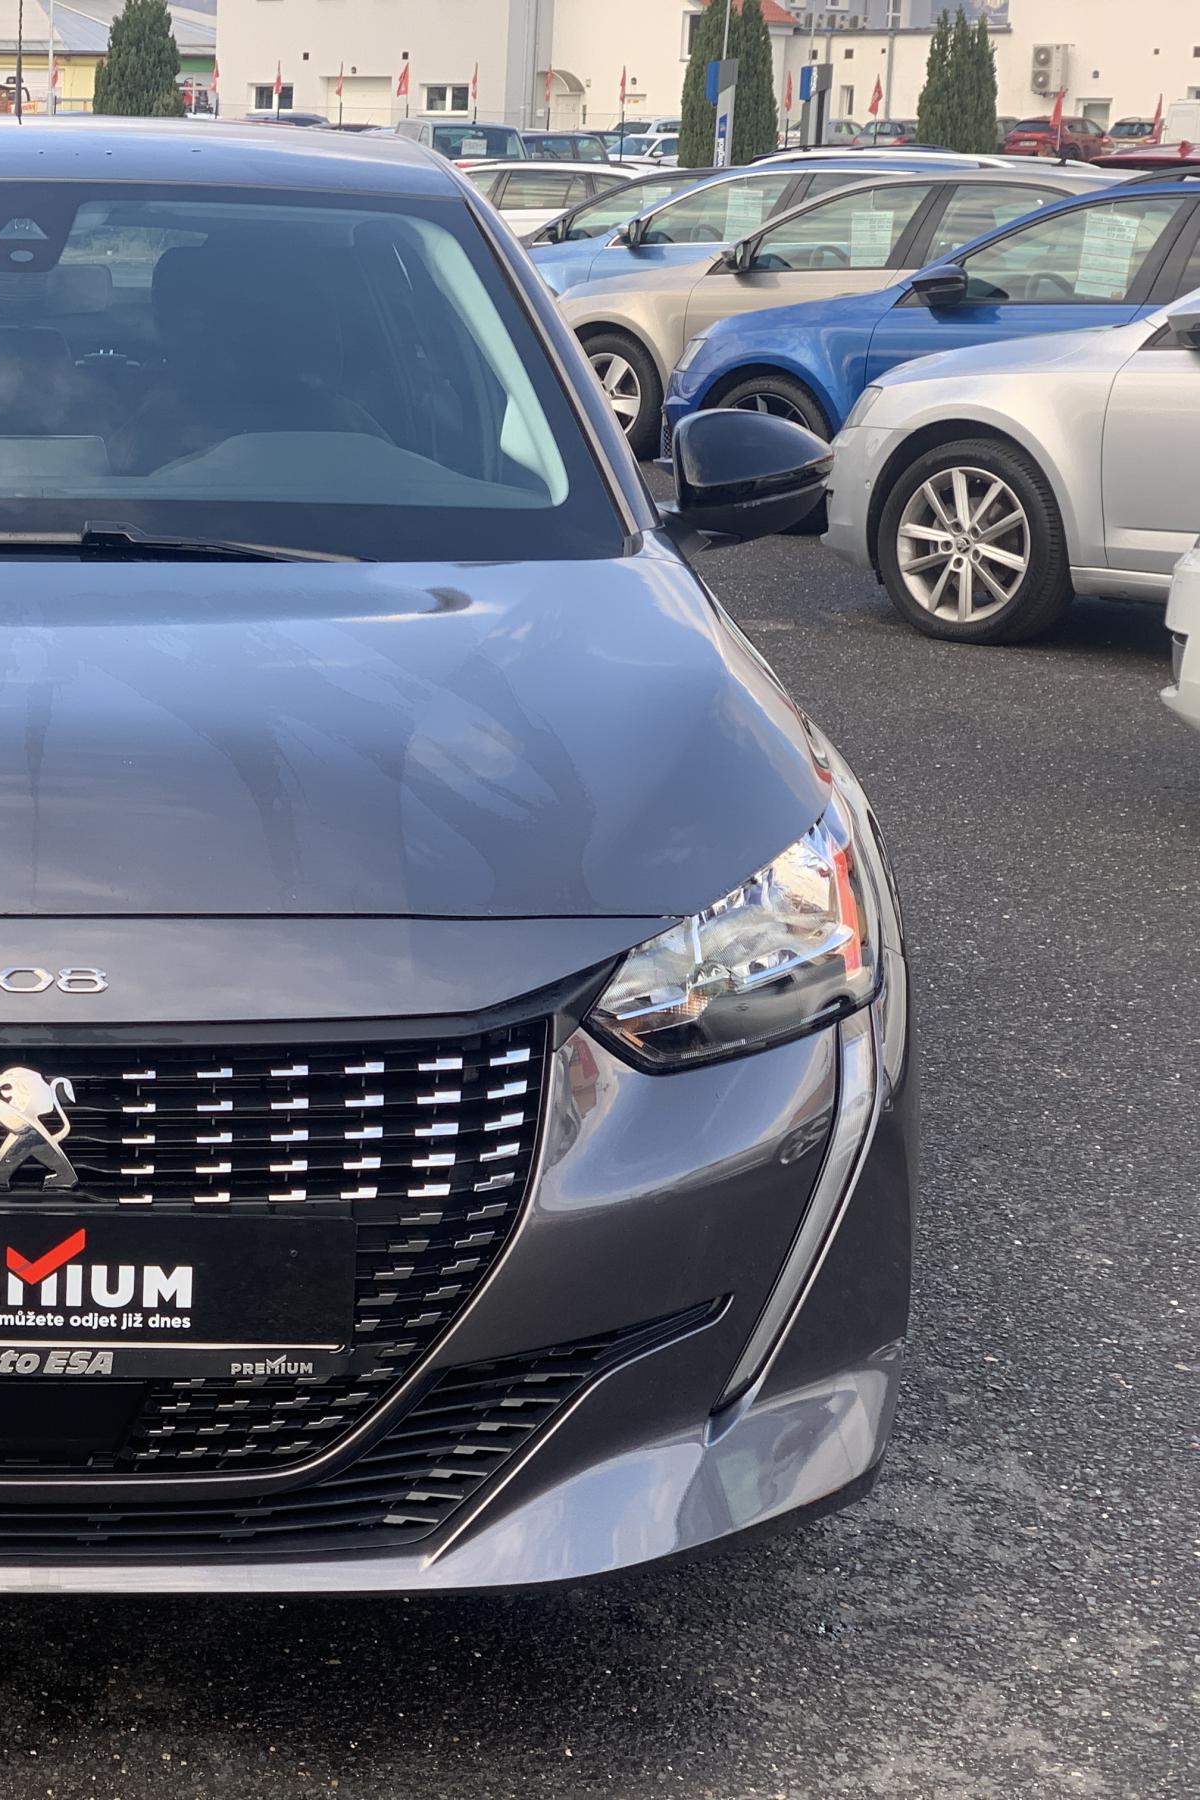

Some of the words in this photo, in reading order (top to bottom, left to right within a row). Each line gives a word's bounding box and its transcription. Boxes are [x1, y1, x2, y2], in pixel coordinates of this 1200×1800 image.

[69, 1312, 117, 1331] odjet
[121, 1312, 143, 1331] již
[148, 1313, 192, 1329] dnes
[42, 1350, 114, 1376] ESA
[231, 1358, 313, 1376] PREMIUM
